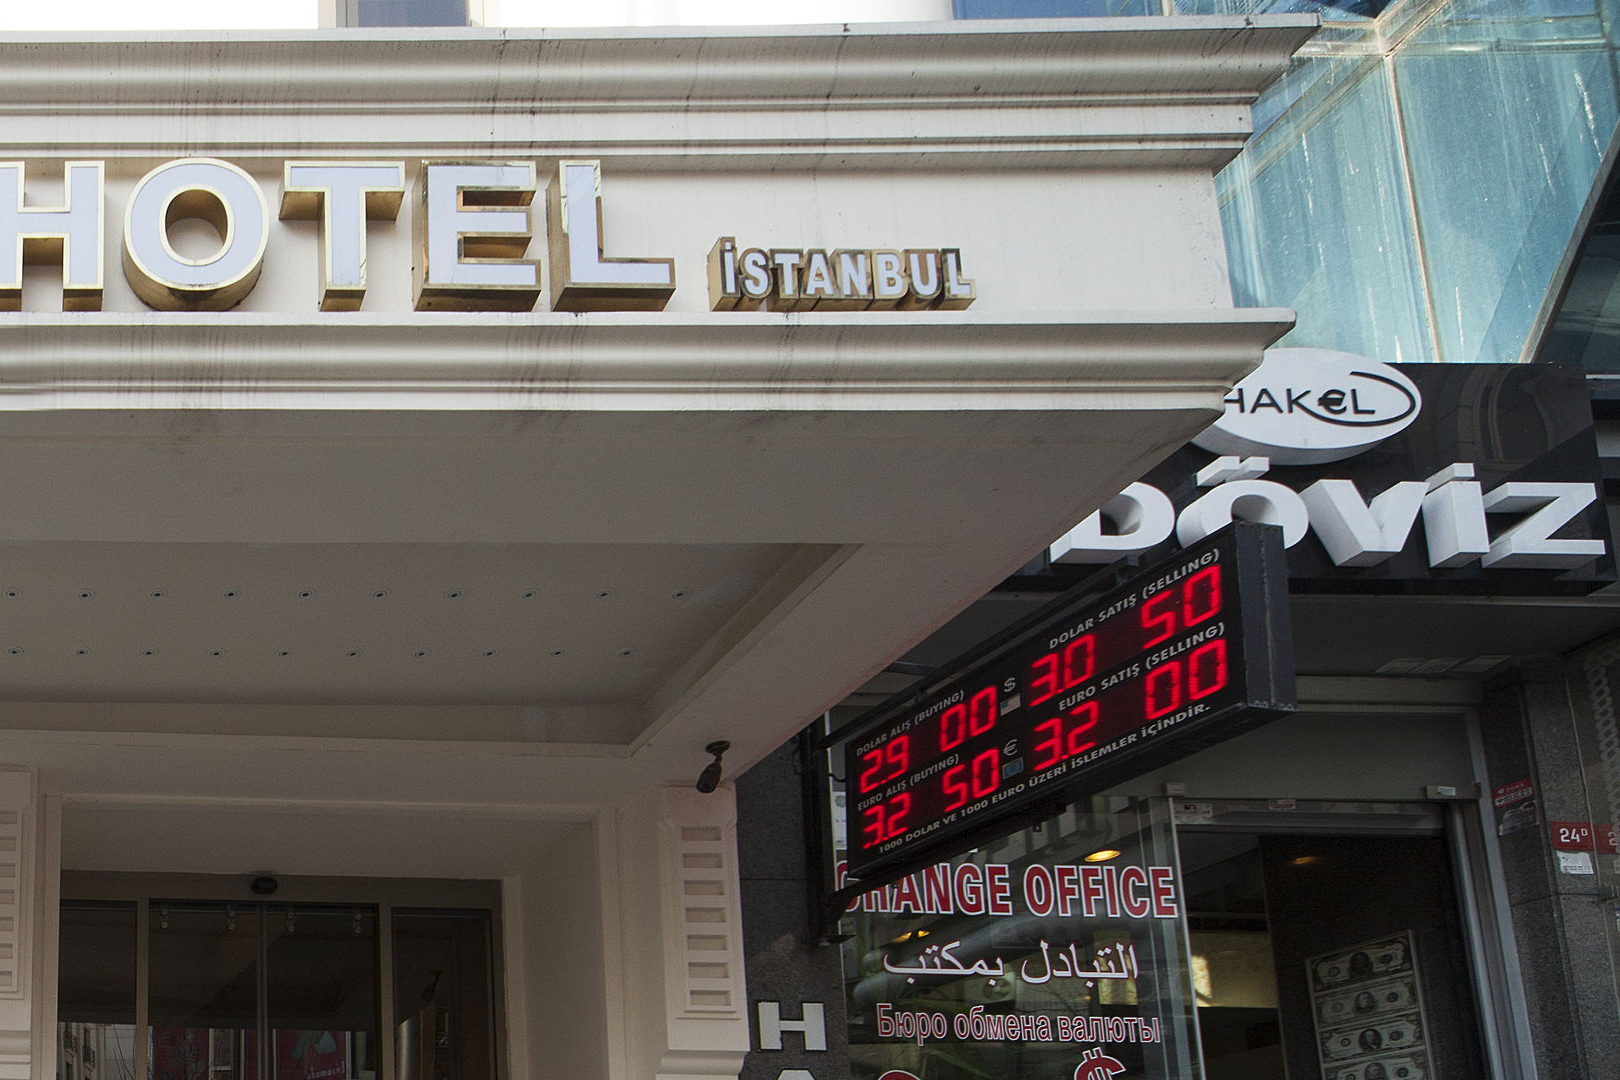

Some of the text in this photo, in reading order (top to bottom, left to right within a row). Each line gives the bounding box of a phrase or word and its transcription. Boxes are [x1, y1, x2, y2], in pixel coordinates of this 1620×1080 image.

[714, 237, 975, 304] İSTANBUL
[1049, 548, 1220, 649] DOLAR SATIŞ (SELLING)
[1141, 564, 1222, 650] 50
[1059, 622, 1225, 711] EURO SATIŞ (SELLING)
[1145, 637, 1227, 720] 00
[856, 690, 964, 757] DOLAR ALIŞ (BUYING)
[940, 686, 997, 752] 00
[857, 753, 960, 812] EURO ALIŞ (BUYING)
[879, 838, 903, 854] 1000
[905, 821, 941, 842] DOLAR
[943, 813, 957, 825] VE
[961, 800, 988, 817] 1000
[992, 783, 1025, 804] EURO
[1029, 764, 1068, 788] ÜZERİ
[942, 748, 1000, 813] 50
[1024, 864, 1179, 919] OFFICE
[1021, 939, 1139, 987] التبادل
[877, 1002, 1161, 1046] Бюро обмена валюты
